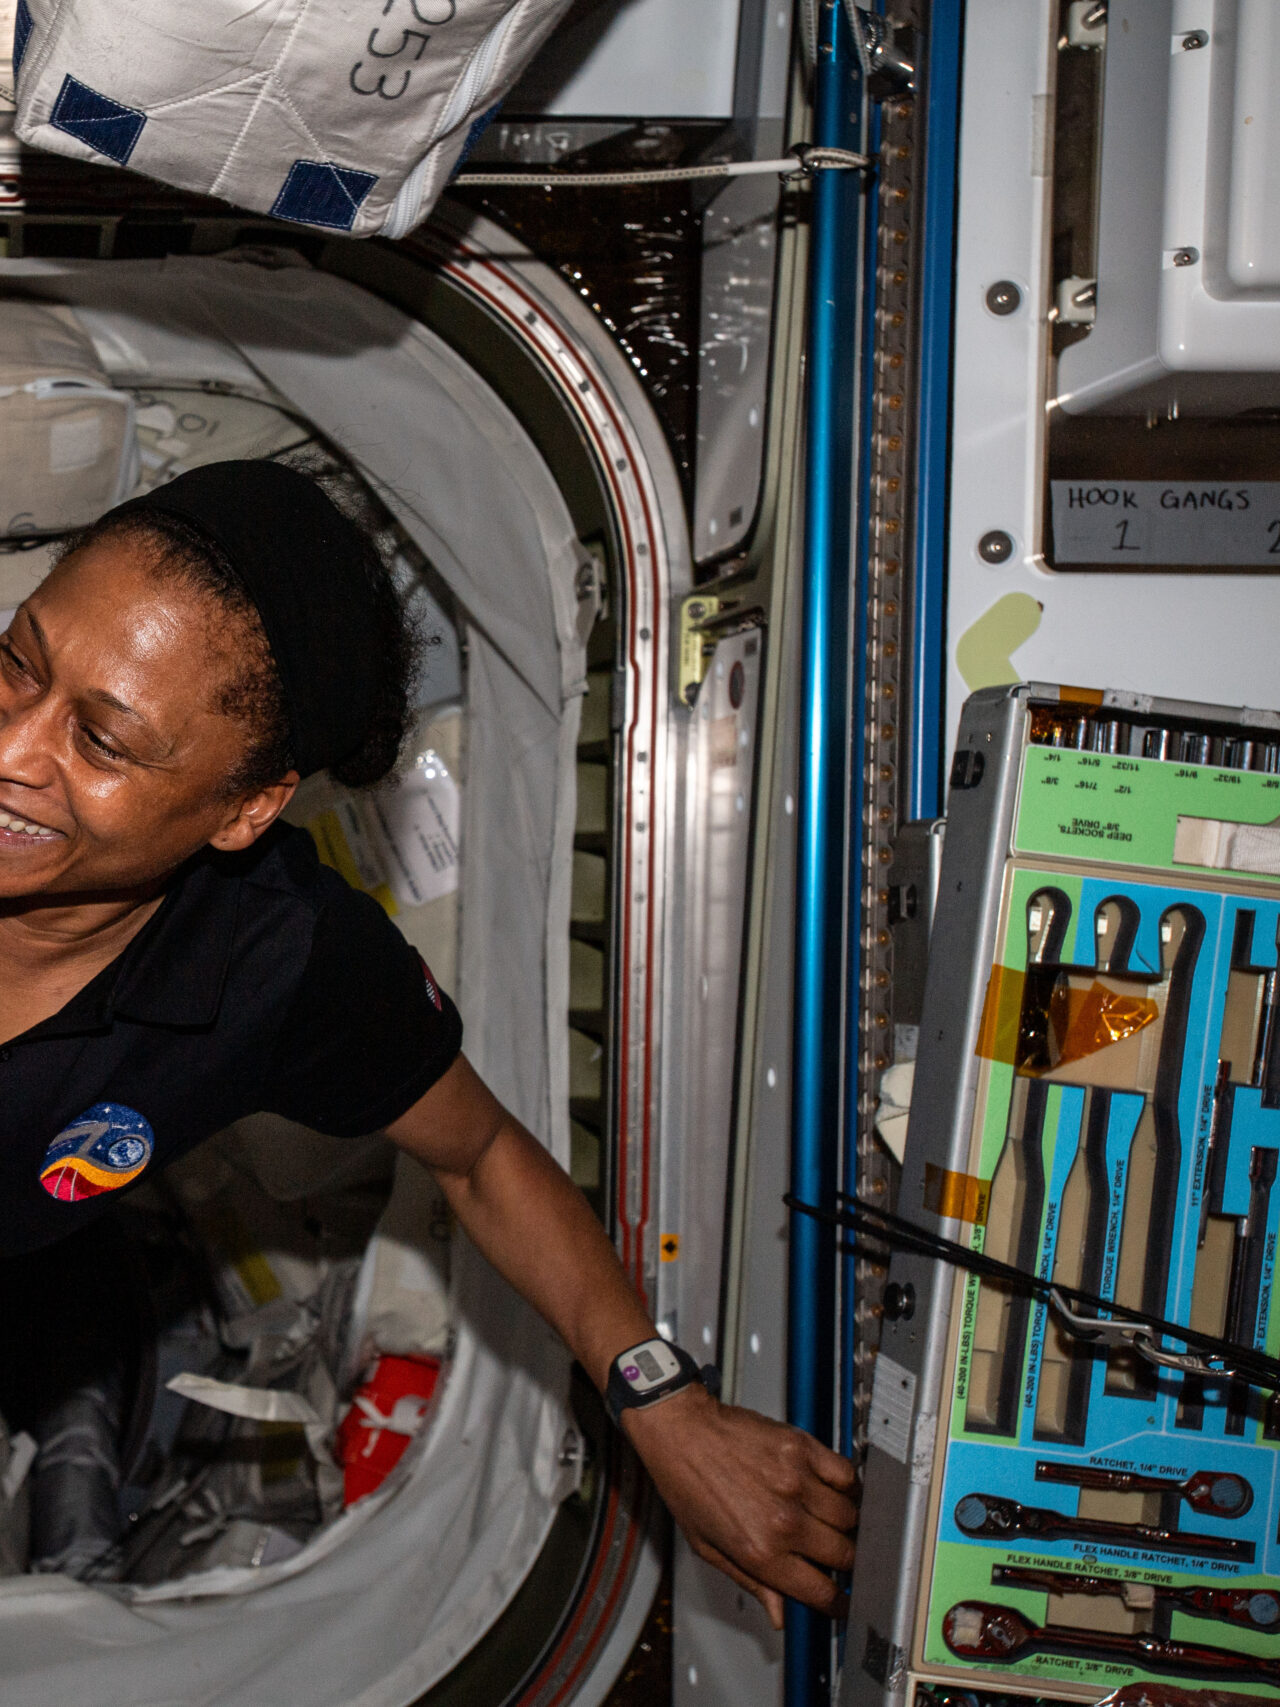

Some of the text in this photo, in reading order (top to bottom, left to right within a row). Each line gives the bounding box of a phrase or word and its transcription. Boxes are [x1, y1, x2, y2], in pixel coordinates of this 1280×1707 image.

[1068, 487, 1250, 511] HOOK GANGS
[1112, 518, 1141, 550] 1
[1044, 753, 1061, 762] 1/4"
[1078, 757, 1100, 767] 5/16"
[1112, 761, 1139, 772] 11/32"
[1041, 776, 1132, 794] 1/2" 7/16" 3/8"
[1058, 824, 1133, 842] DEEP SOCKETS,
[1072, 818, 1120, 831] 3/8" DRIVE
[1202, 1085, 1213, 1113] DRIVE
[1200, 1115, 1208, 1132] 1/4"
[1114, 1159, 1125, 1187] DRIVE
[1193, 1136, 1207, 1190] EXTENSION,
[976, 1193, 987, 1221] DRIVE
[1112, 1190, 1120, 1207] 1/4"
[1046, 1201, 1057, 1231] DRIVE
[1044, 1233, 1052, 1249] 1/4"
[1107, 1210, 1120, 1253] WRENCH,
[1040, 1250, 1051, 1280] ENCH,
[1102, 1255, 1115, 1294] TORQUE
[1257, 1283, 1272, 1338] EXTENSION,
[1265, 1232, 1276, 1261] DRIVE
[964, 1290, 976, 1328] TORQUE
[1032, 1302, 1045, 1337] TORQU
[960, 1331, 972, 1365] IN-LBS)
[1029, 1341, 1042, 1373] IN-LBS)
[1089, 1456, 1188, 1476] RATCHET, 1/4" DRIVE
[1006, 1554, 1173, 1584] FLEX HANDLE RATCHET, 3/8" DRIVE
[1073, 1543, 1241, 1574] FLEX HANDLE RATCHET, 1/4" DRIVE
[1035, 1655, 1134, 1676] RATCHET, 3/8" DRIVE
